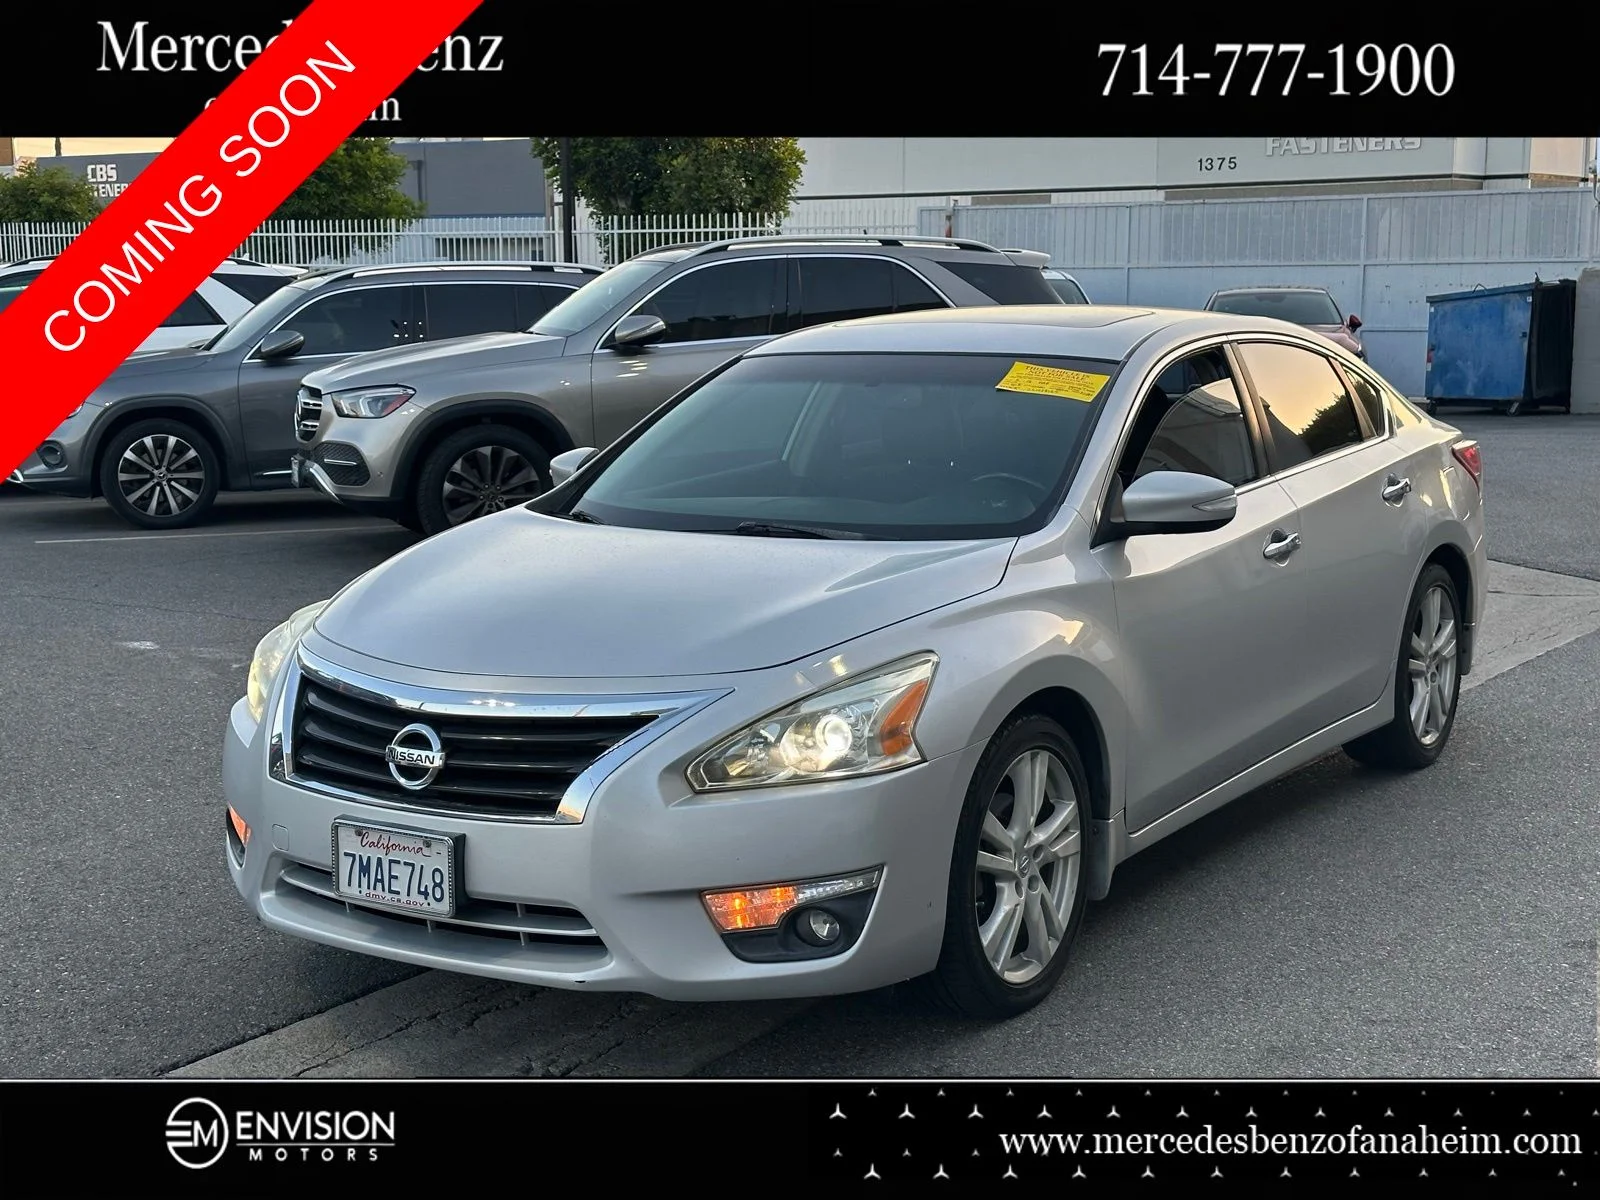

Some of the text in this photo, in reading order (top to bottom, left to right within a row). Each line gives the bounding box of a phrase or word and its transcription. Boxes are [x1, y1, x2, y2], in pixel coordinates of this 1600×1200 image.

[1198, 156, 1237, 171] 1375
[87, 164, 117, 182] CBS
[387, 748, 436, 766] NISSAN
[360, 831, 432, 858] California
[343, 851, 445, 903] 7MAE748
[365, 891, 425, 907] dmv.ca.gov
